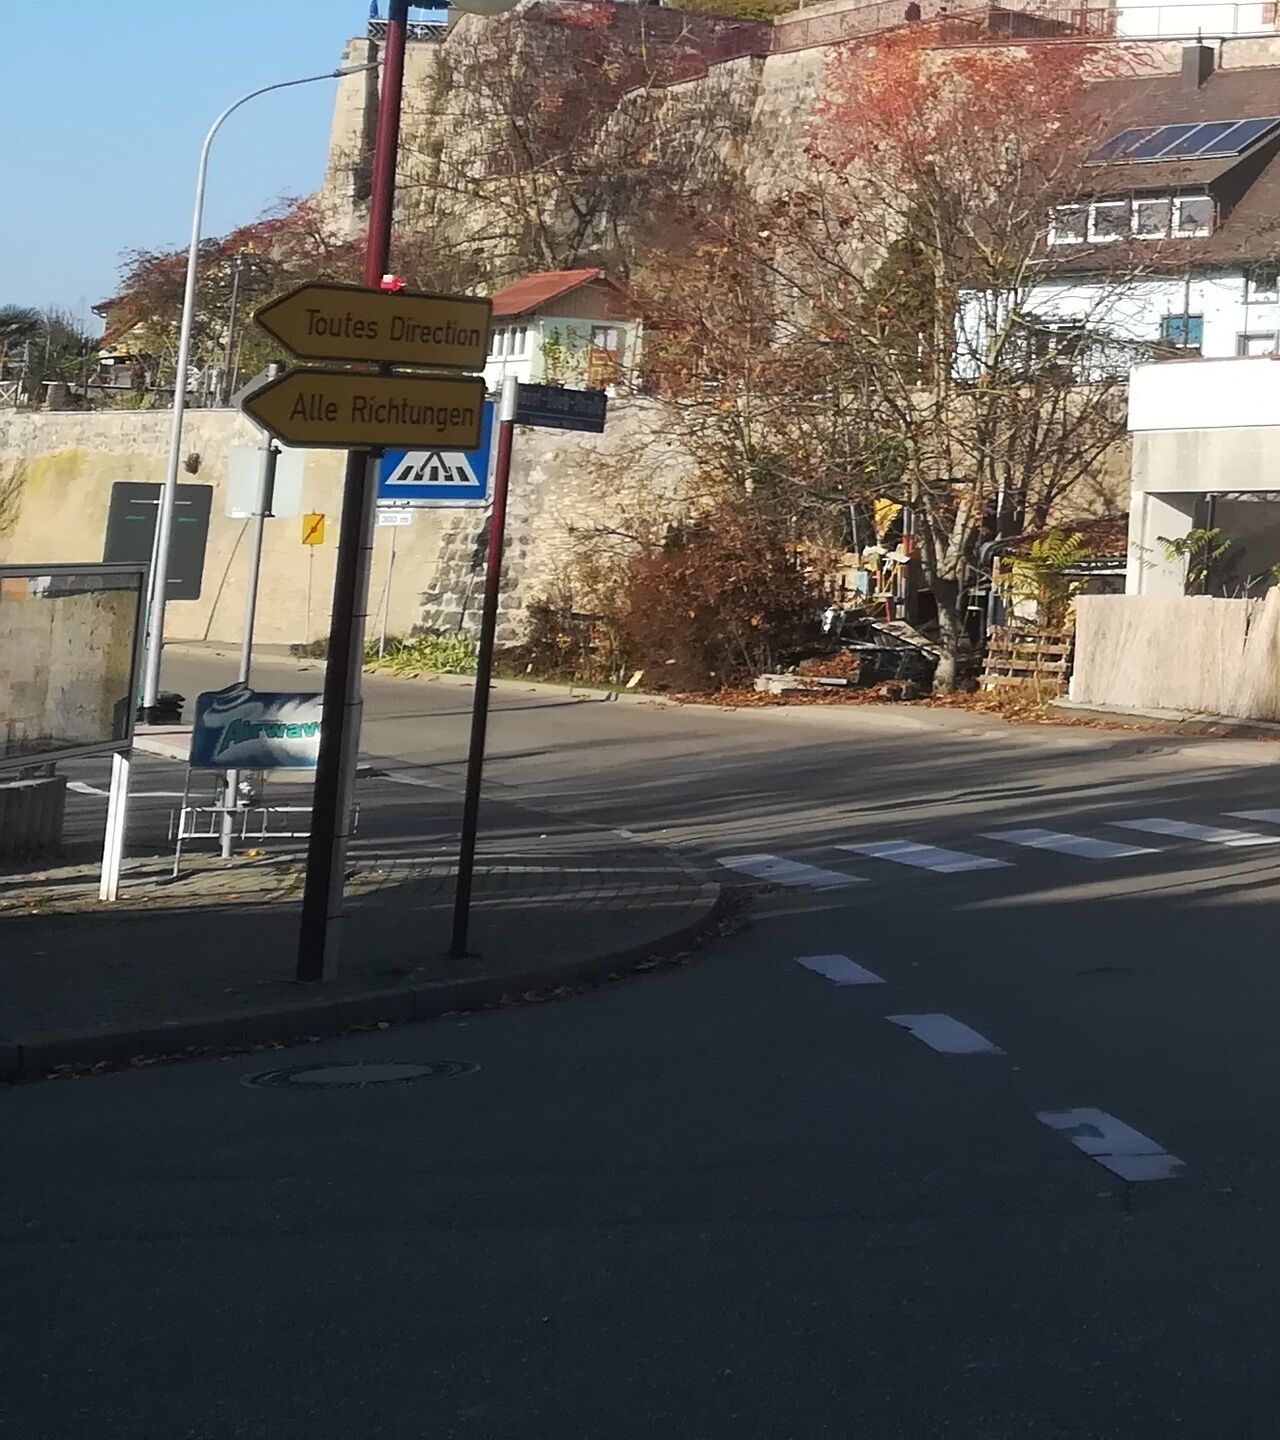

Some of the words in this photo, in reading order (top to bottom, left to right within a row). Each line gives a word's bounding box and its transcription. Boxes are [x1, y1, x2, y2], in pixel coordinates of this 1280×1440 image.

[306, 309, 378, 340] Toutes
[389, 315, 481, 348] Direction
[290, 394, 338, 422] Alle
[352, 395, 474, 433] Richtungen
[216, 717, 324, 757] Airwav
